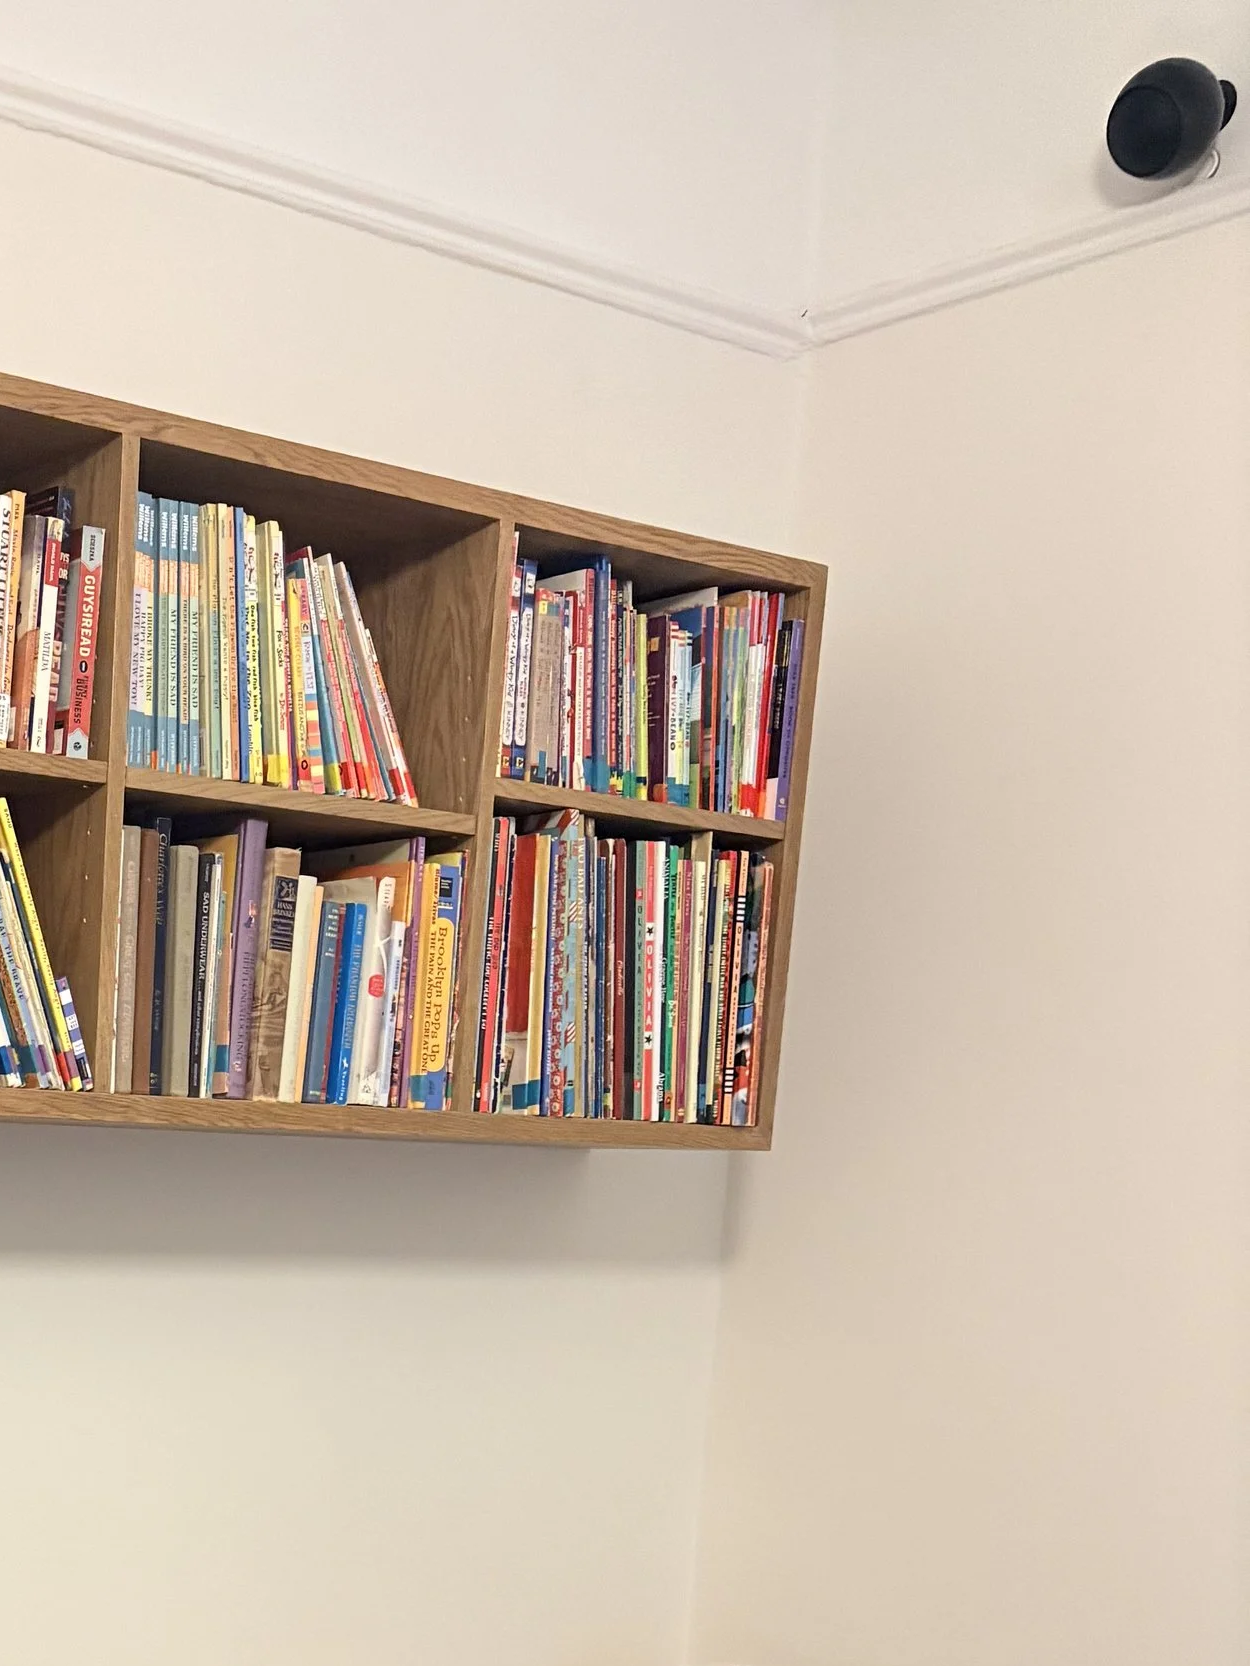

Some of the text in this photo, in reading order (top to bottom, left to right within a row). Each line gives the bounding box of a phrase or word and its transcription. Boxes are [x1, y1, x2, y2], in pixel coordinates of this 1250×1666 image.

[142, 506, 150, 542] Willems
[160, 512, 168, 547] Willems
[170, 513, 178, 549] Willems
[182, 515, 190, 550] Willems
[191, 515, 199, 551] Willems
[133, 600, 141, 628] LOVE
[170, 609, 177, 624] MY
[191, 611, 198, 626] MY
[41, 631, 51, 671] MATILDA
[132, 632, 139, 646] MY
[131, 650, 139, 677] NEW
[170, 672, 177, 682] IS
[191, 674, 198, 684] IS
[507, 655, 516, 681] Wimpy
[73, 678, 84, 724] BUSINESS
[130, 680, 138, 705] TOY!
[507, 683, 515, 697] Kid
[576, 836, 585, 929] TWO BAD ANTS
[635, 905, 643, 975] OLIVIA
[4, 946, 15, 964] THE
[11, 967, 25, 1000] BRAVE
[733, 925, 742, 993] OLIVIA
[429, 927, 448, 1063] Brooklyn Pops Up
[644, 940, 654, 1031] OLIVIA
